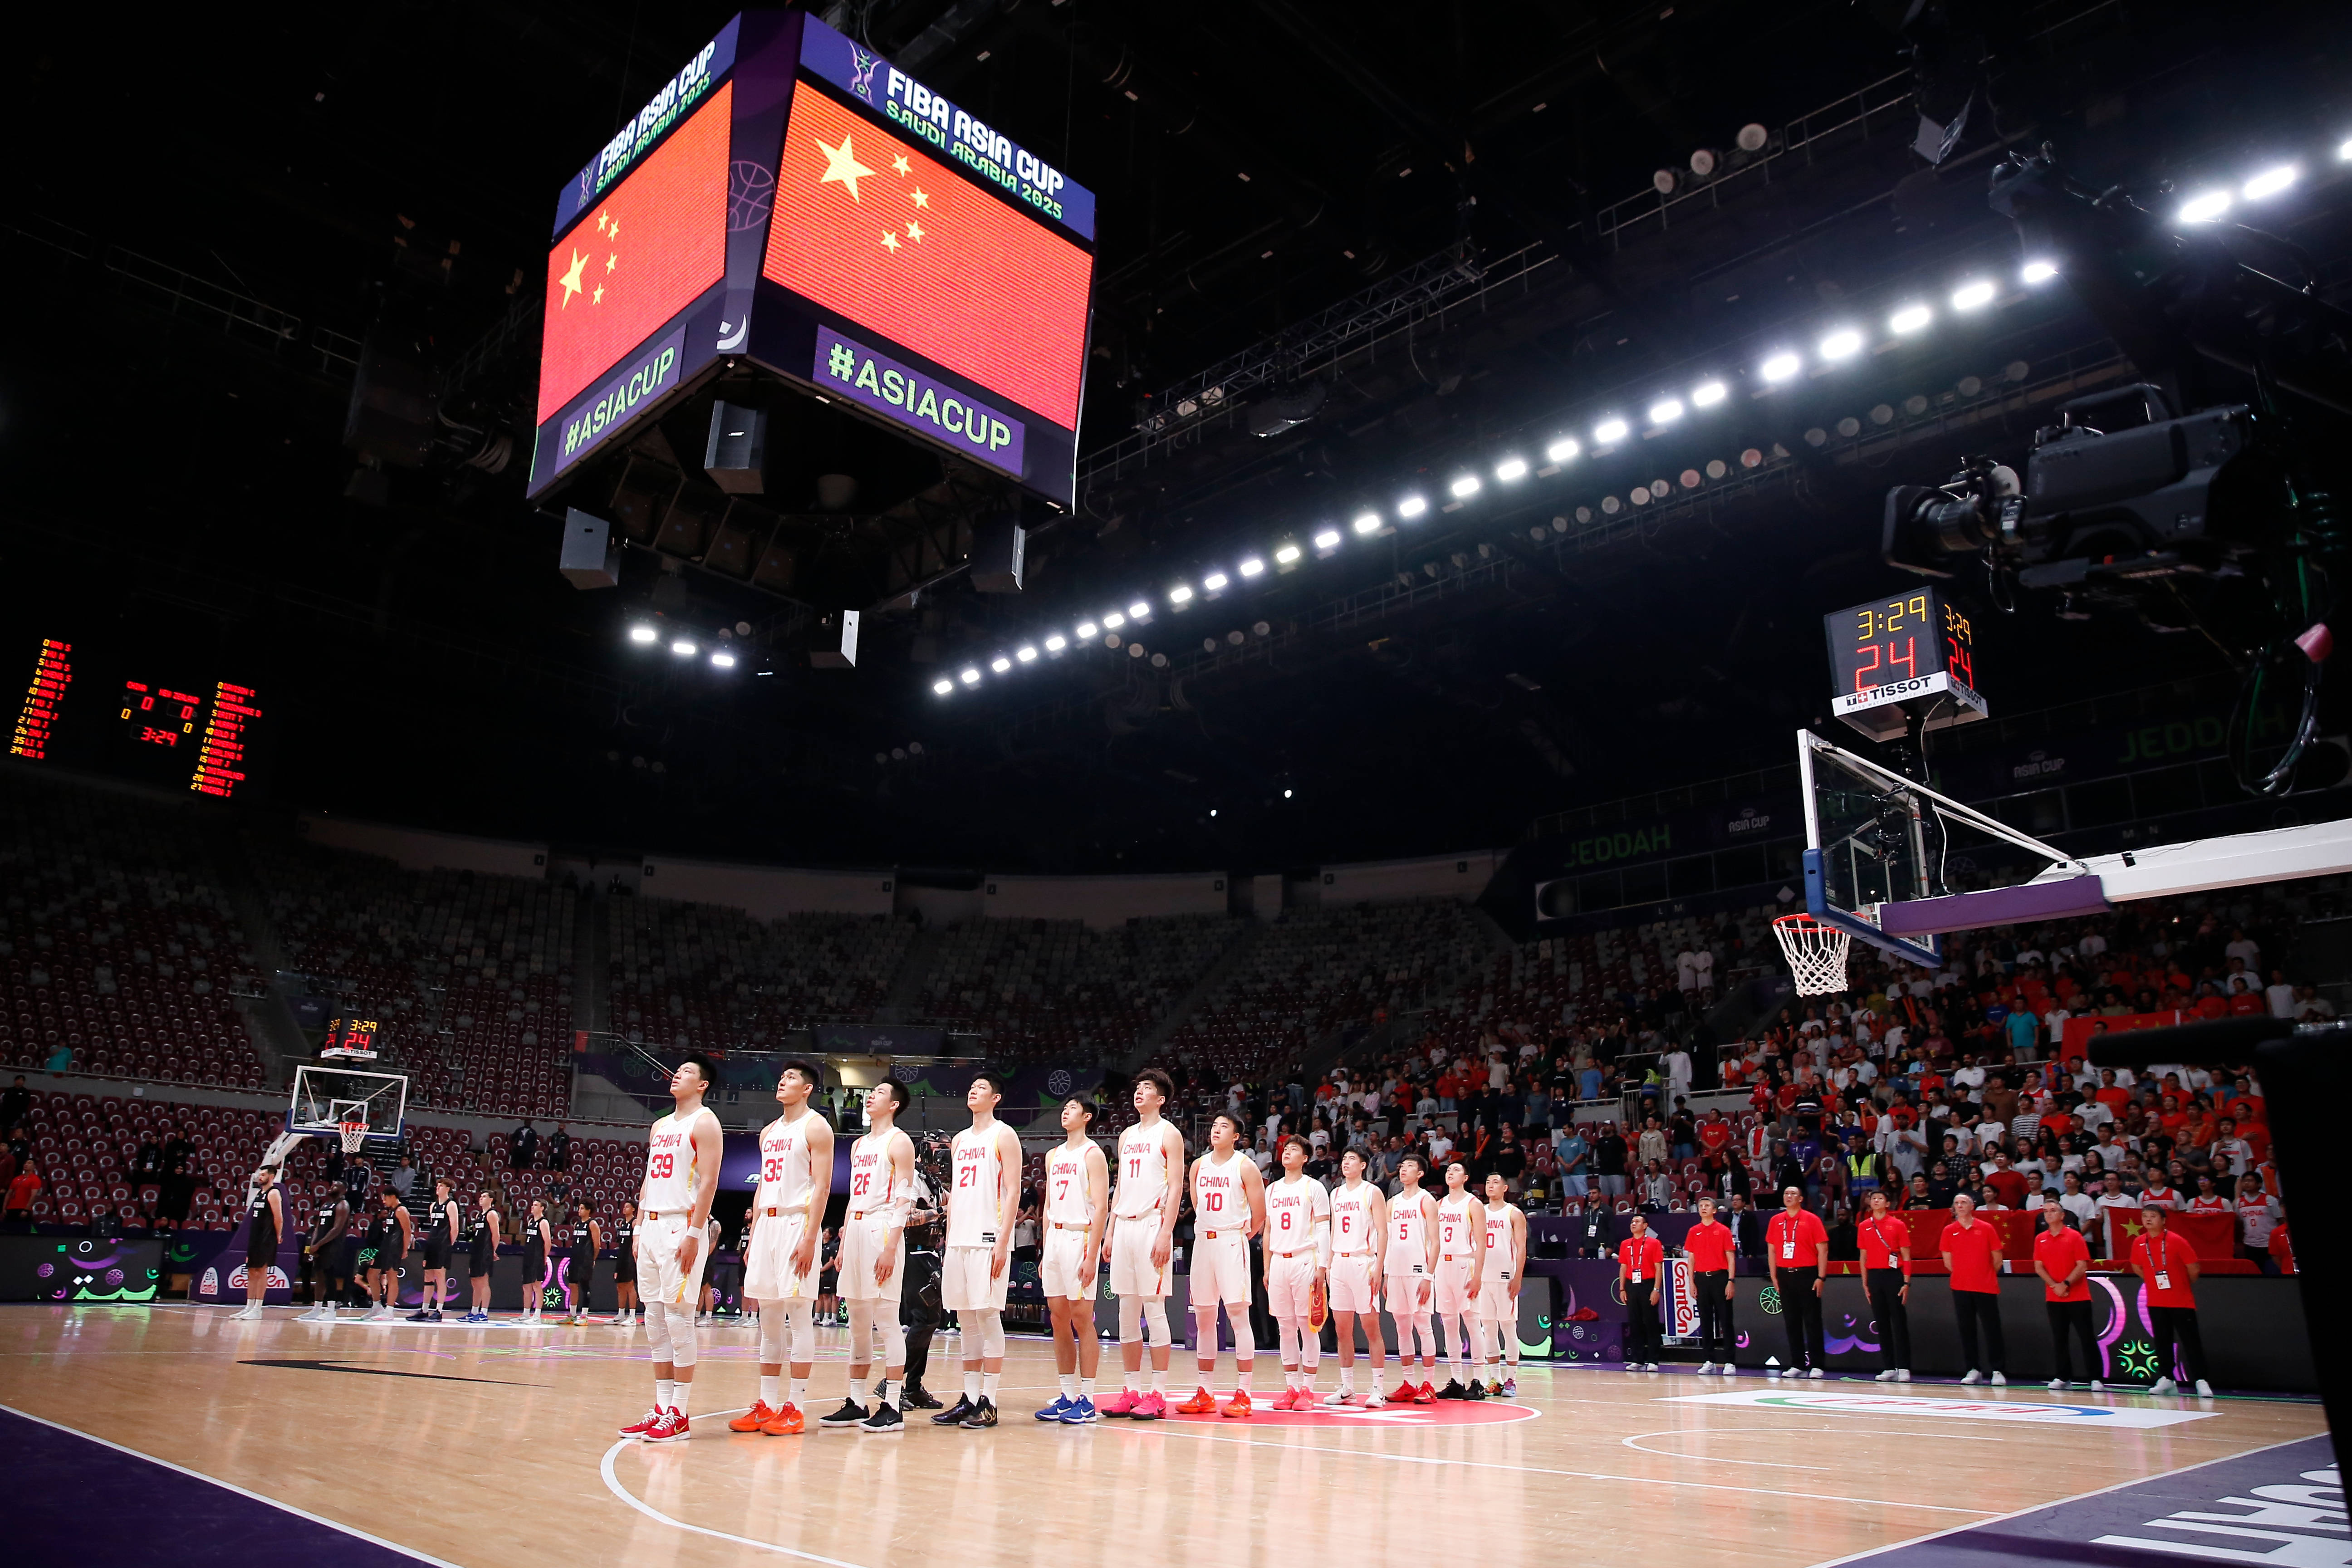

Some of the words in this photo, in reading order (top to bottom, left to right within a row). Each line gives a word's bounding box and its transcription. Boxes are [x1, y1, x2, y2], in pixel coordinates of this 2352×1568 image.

[598, 119, 636, 176] FIBA
[637, 78, 677, 138] ASIA
[678, 40, 715, 96] CUP
[595, 148, 631, 194] SAUDI
[632, 103, 678, 159] ARABIA
[679, 71, 711, 113] 2025
[887, 67, 950, 131] FIBA
[954, 110, 1012, 169] ASIA
[1016, 149, 1064, 196] CUP
[886, 99, 946, 149] SAUDI
[951, 141, 1018, 192] ARABIA
[1021, 183, 1063, 220] 2025
[564, 346, 675, 456] #ASIACUP
[828, 342, 1011, 453] #ASIACUP
[1857, 595, 1926, 641] 3:29
[1945, 603, 1971, 645] 3:29
[1855, 637, 1915, 692] 24
[1948, 637, 1974, 690] 24
[29, 686, 38, 695] 10
[1870, 677, 1931, 699] TISSOT
[141, 696, 155, 711] 0
[18, 715, 31, 725] 21
[121, 708, 131, 720] 0
[181, 705, 194, 720] 0
[15, 725, 27, 735] 26
[183, 722, 193, 733] 0
[2118, 704, 2287, 764] JEDDH
[13, 735, 25, 745] 35
[140, 727, 178, 746] 3:29
[10, 745, 23, 755] 39
[201, 746, 210, 754] 12
[199, 755, 208, 763] 15
[197, 764, 206, 773] 16
[2013, 761, 2040, 779] ASIA
[2042, 757, 2065, 774] CUP
[192, 773, 204, 782] 20
[191, 782, 202, 791] 27
[1729, 817, 1750, 833] ASIA
[1751, 815, 1769, 829] CUP
[1564, 824, 1671, 867] JEDDAH
[350, 1019, 377, 1033] 3:29
[343, 1032, 370, 1050] 24
[957, 1147, 985, 1161] CHINA
[1123, 1143, 1150, 1154] CHINA
[651, 1153, 673, 1178] 39
[853, 1153, 878, 1168] CHINA
[1129, 1158, 1140, 1178] 11
[764, 1157, 784, 1182] 35
[960, 1165, 977, 1187] 21
[1052, 1163, 1077, 1175] CHINA
[1200, 1176, 1229, 1187] CHINA
[1205, 1192, 1223, 1211] 10
[1272, 1196, 1300, 1208] CHINA
[1335, 1201, 1360, 1212] CHINA
[1281, 1212, 1291, 1230] 8
[1393, 1209, 1417, 1220] CHINA
[1439, 1213, 1461, 1223] CHINA
[1342, 1216, 1350, 1233] 6
[1400, 1224, 1407, 1240] 5
[1486, 1220, 1504, 1230] HINA
[1444, 1227, 1453, 1242] 3
[1486, 1233, 1494, 1248] 0
